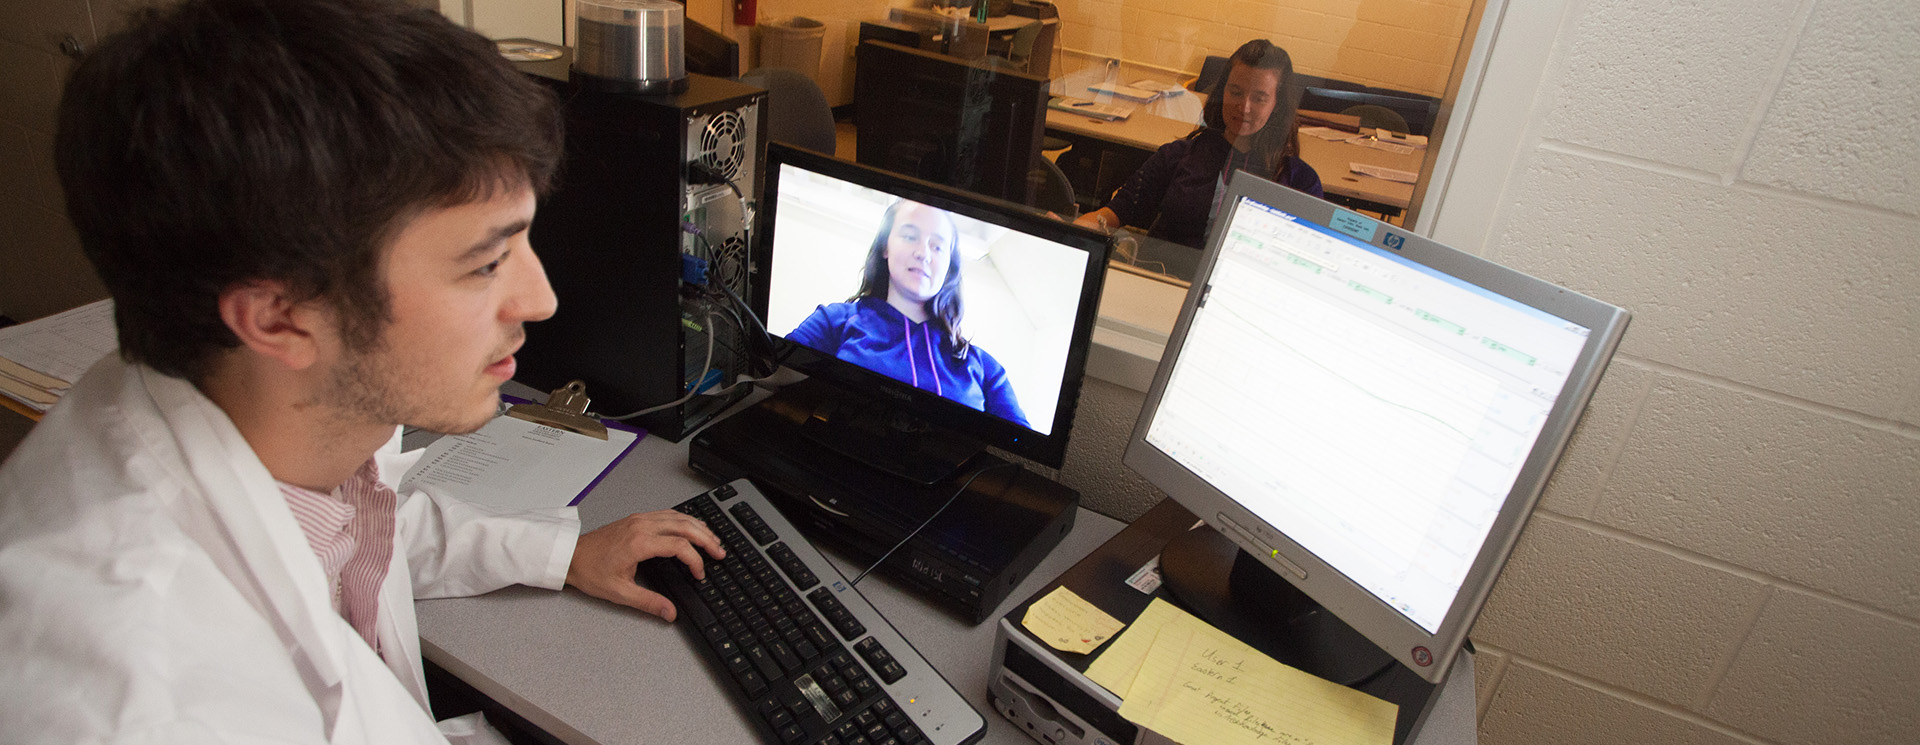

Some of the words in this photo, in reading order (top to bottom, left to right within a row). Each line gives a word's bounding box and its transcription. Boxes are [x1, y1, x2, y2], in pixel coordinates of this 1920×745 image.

[1385, 233, 1402, 250] hp
[1201, 648, 1230, 666] User
[1191, 662, 1223, 680] Eastern
